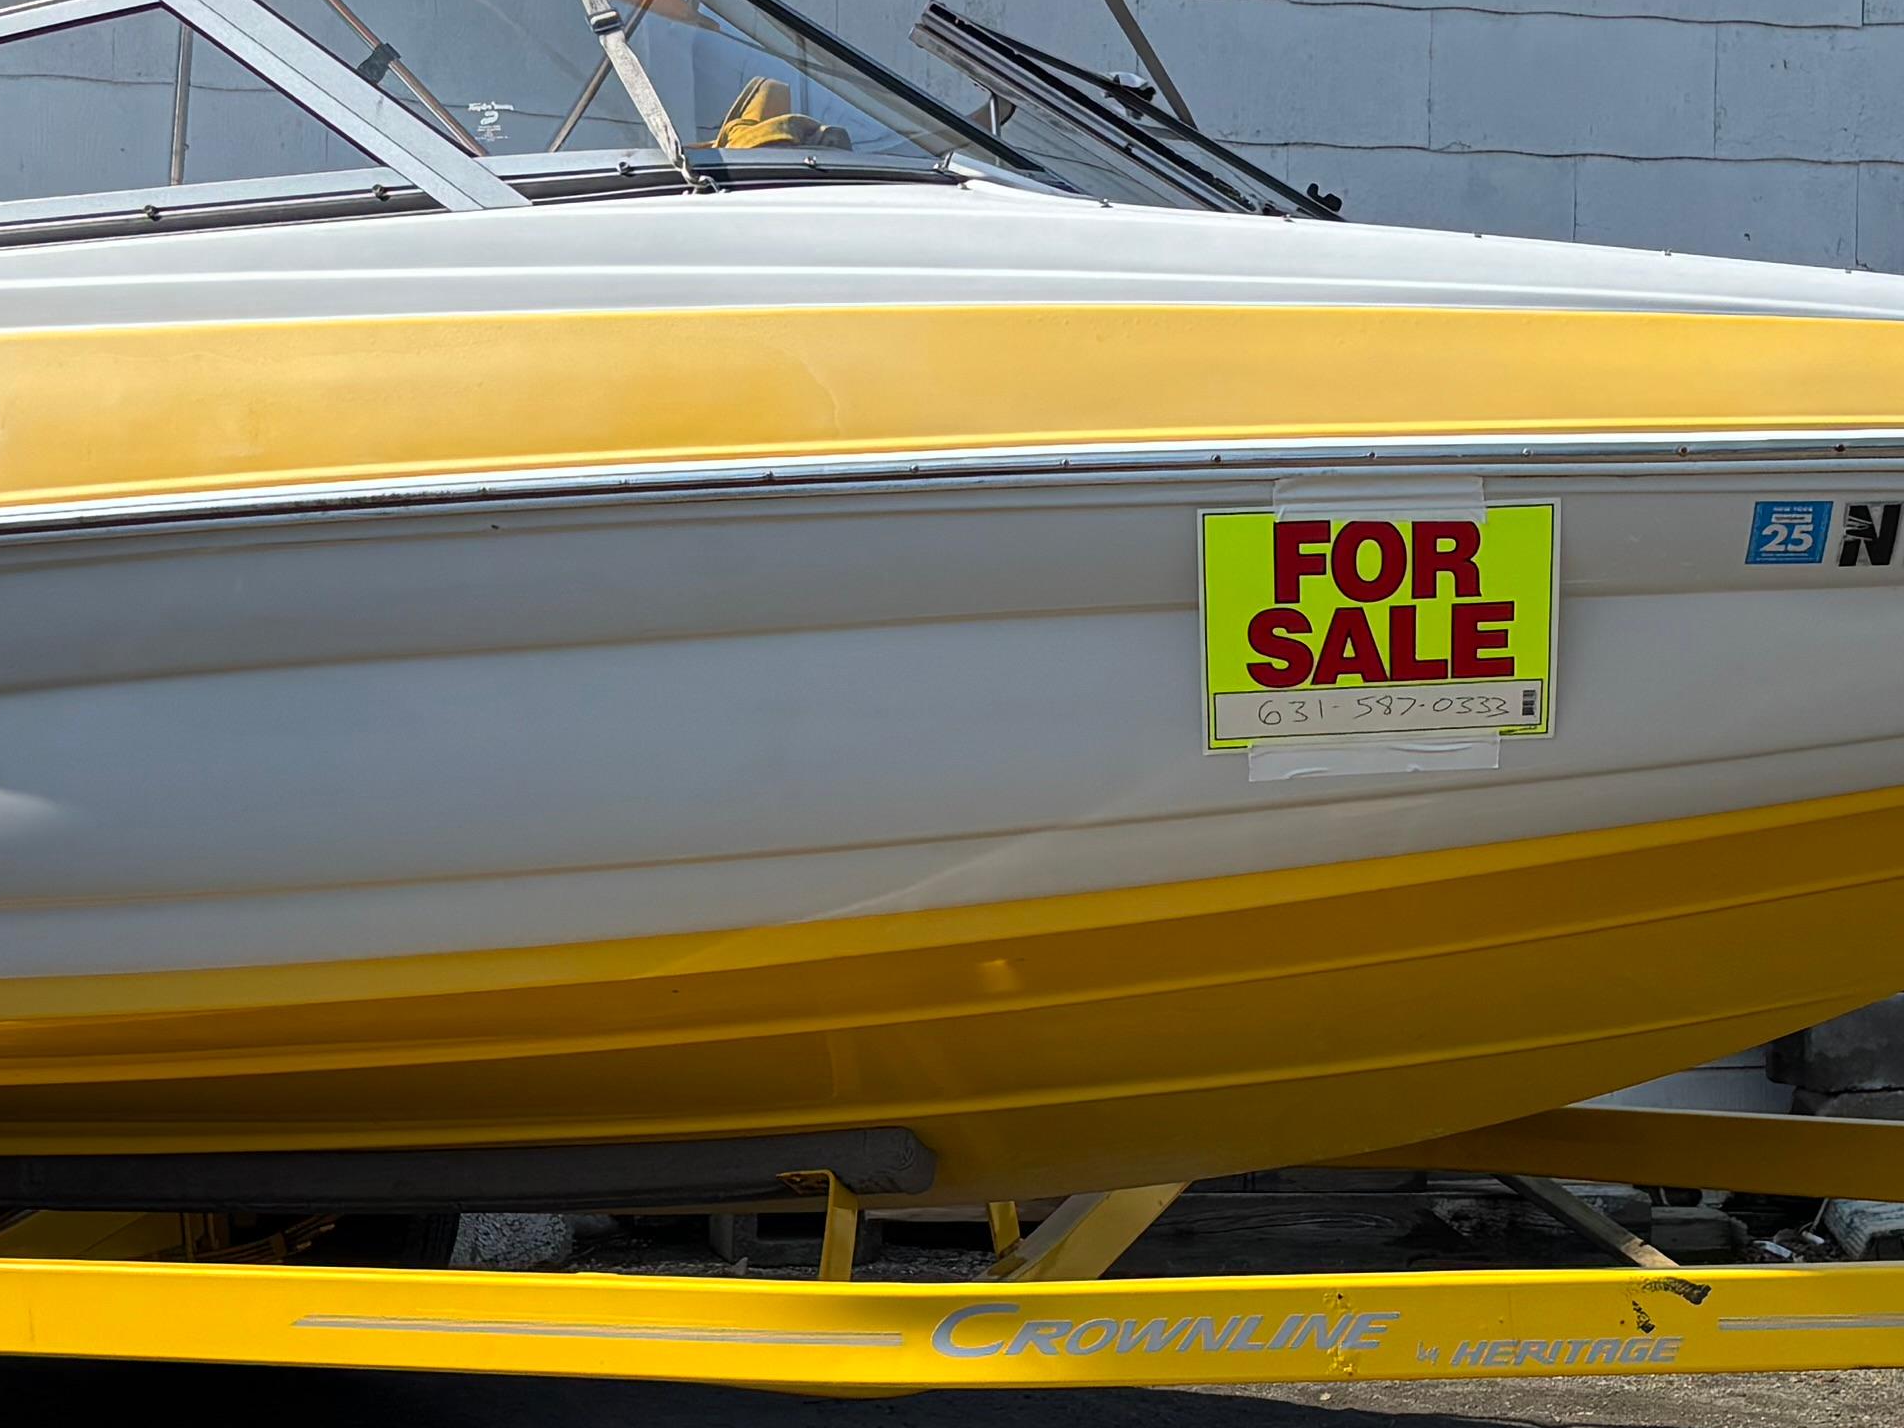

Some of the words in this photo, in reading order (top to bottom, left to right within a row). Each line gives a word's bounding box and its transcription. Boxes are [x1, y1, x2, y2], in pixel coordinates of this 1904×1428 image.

[1273, 520, 1482, 604] FOR
[1760, 523, 1814, 552] 25
[1246, 601, 1515, 688] SALE
[930, 1302, 1401, 1358] CROWNLINE
[1415, 1341, 1440, 1365] by
[1450, 1336, 1684, 1366] HERITAGE
